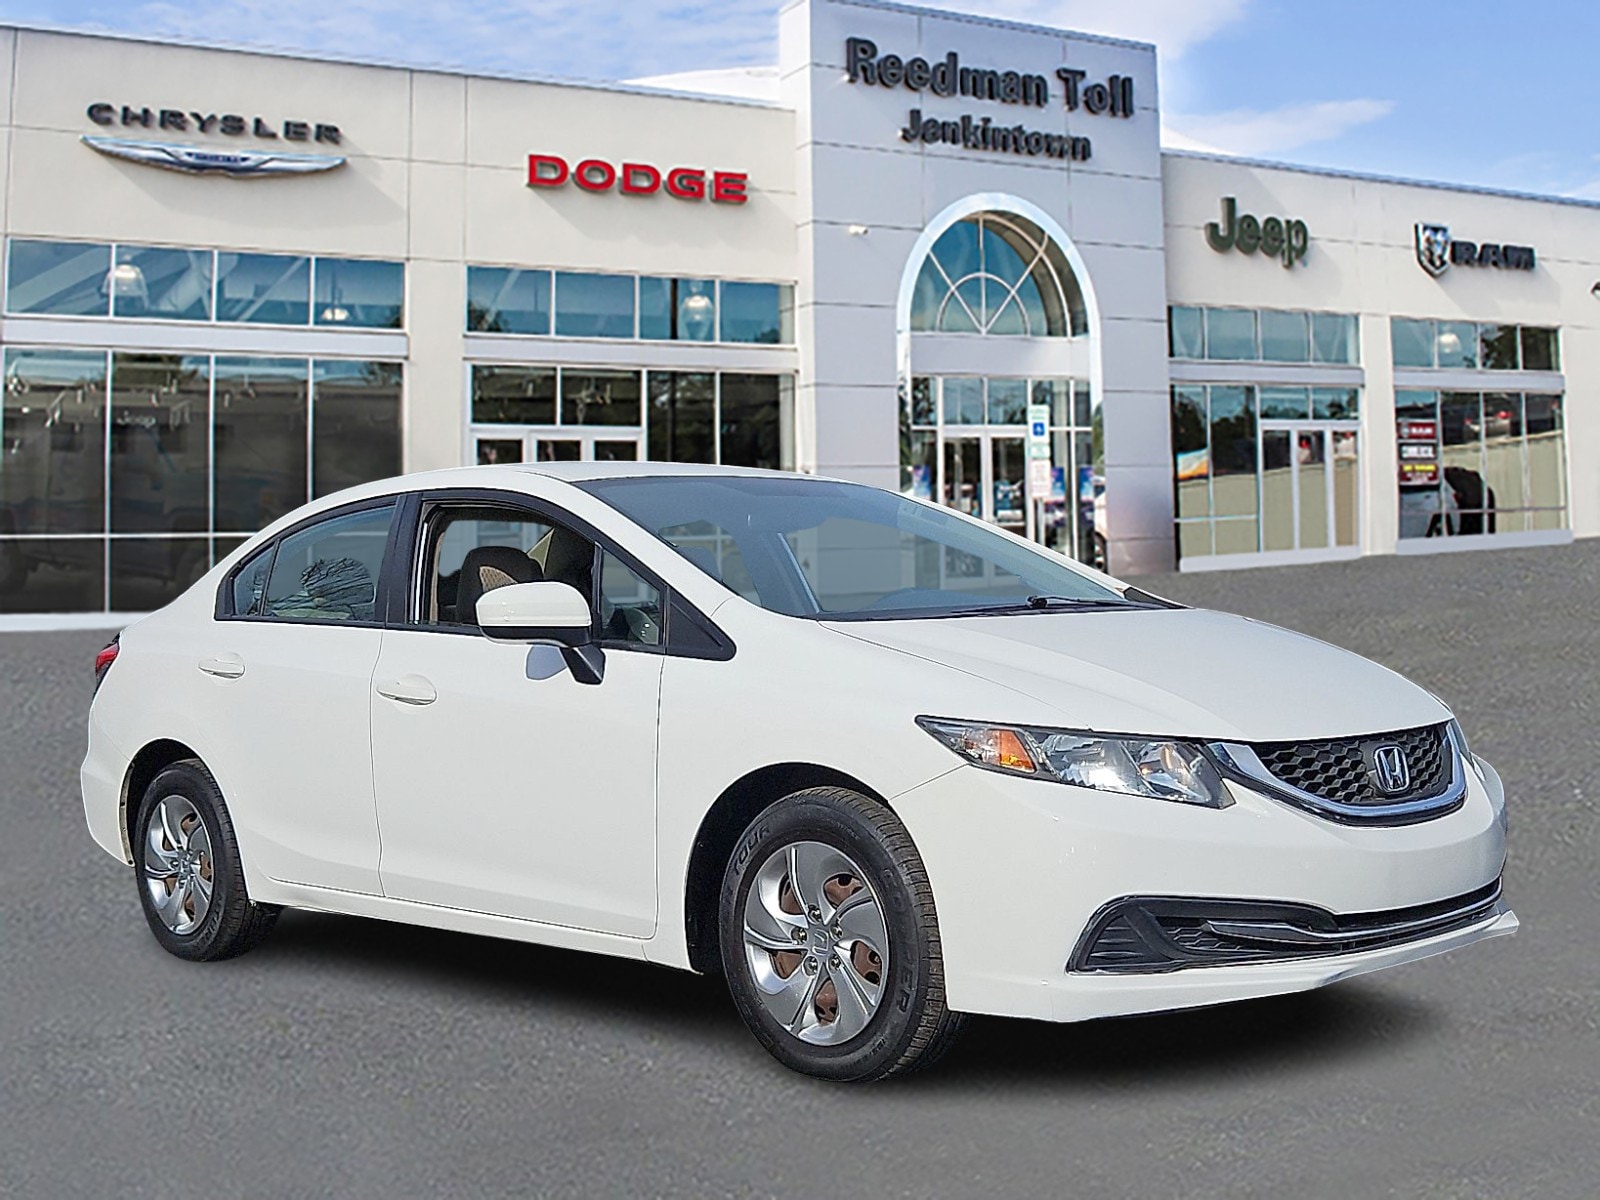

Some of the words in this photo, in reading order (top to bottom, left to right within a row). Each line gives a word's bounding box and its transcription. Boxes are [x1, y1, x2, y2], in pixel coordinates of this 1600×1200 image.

[846, 37, 1048, 108] Reedman
[1056, 67, 1134, 118] Toll
[87, 102, 341, 145] CHRYSLER
[901, 109, 1092, 161] Jenkintown
[527, 153, 749, 204] DODGE
[1205, 197, 1308, 269] Jeep
[1450, 240, 1536, 271] RAM
